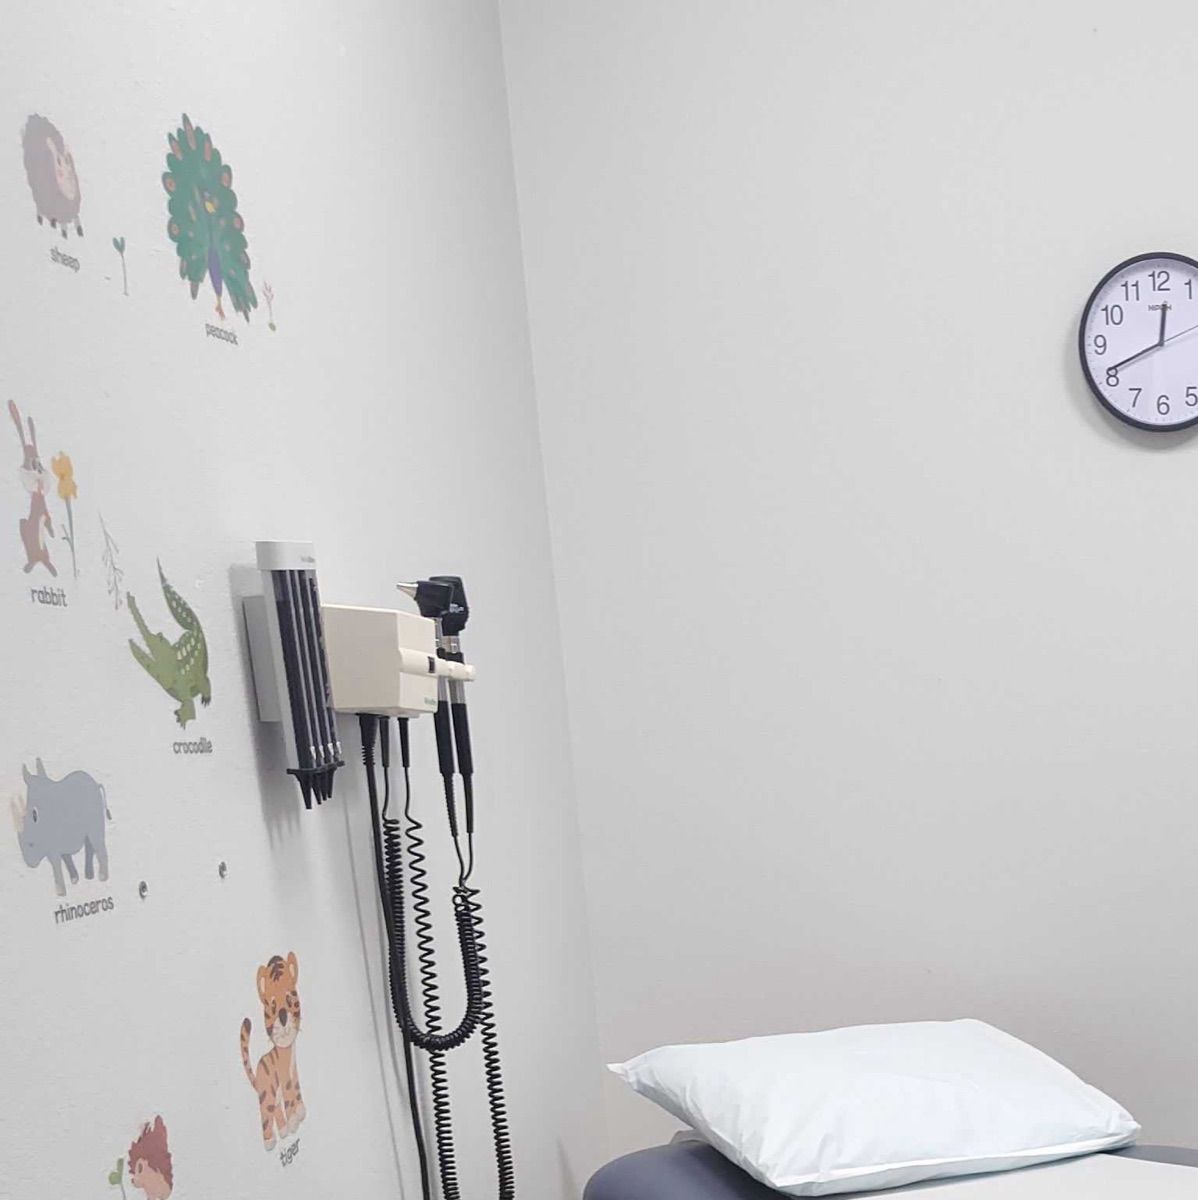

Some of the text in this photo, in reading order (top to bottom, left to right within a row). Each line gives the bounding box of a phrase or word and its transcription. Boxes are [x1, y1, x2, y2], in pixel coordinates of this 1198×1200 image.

[1121, 280, 1140, 301] 11
[1148, 270, 1171, 292] 12
[1184, 279, 1193, 300] 1
[1101, 304, 1124, 326] 10
[1093, 334, 1107, 355] 9
[1105, 366, 1119, 387] 8
[1128, 387, 1142, 408] 7
[1156, 394, 1170, 415] 6
[1185, 386, 1198, 407] 5
[31, 586, 68, 607] rabbit
[173, 737, 213, 754] crocodile
[55, 896, 114, 924] rhinoceros
[280, 1137, 301, 1167] tiger
